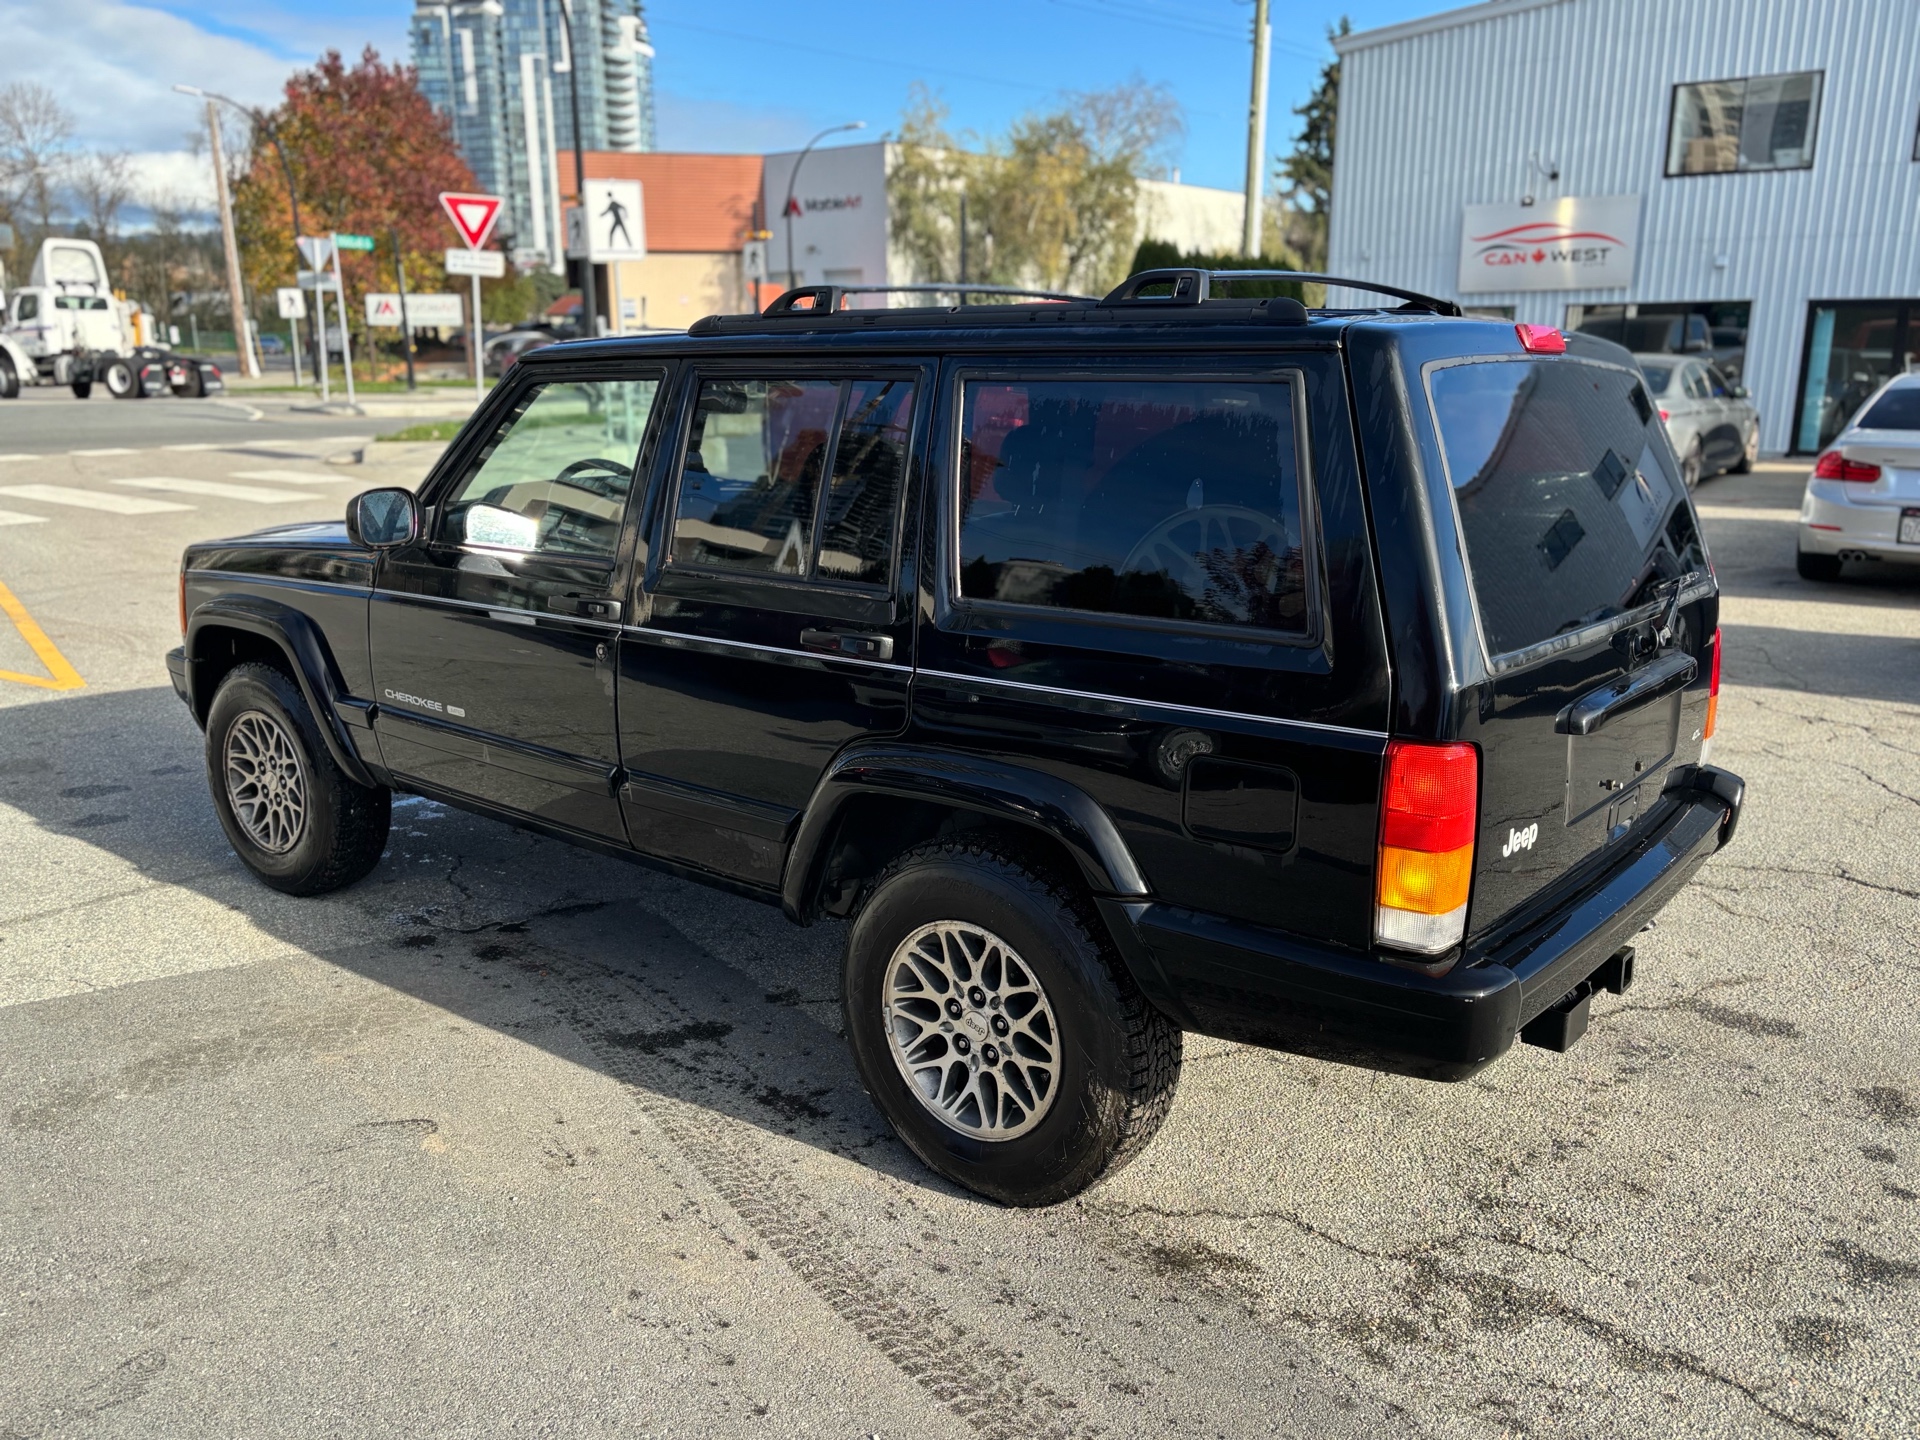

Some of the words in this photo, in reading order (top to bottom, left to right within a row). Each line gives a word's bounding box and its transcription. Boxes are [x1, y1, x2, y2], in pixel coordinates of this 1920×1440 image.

[1484, 252, 1527, 266] CAN
[1551, 248, 1612, 262] WEST
[384, 688, 443, 713] CHEROKEE
[1502, 822, 1538, 858] Jeep
[965, 1017, 986, 1036] Jeep
